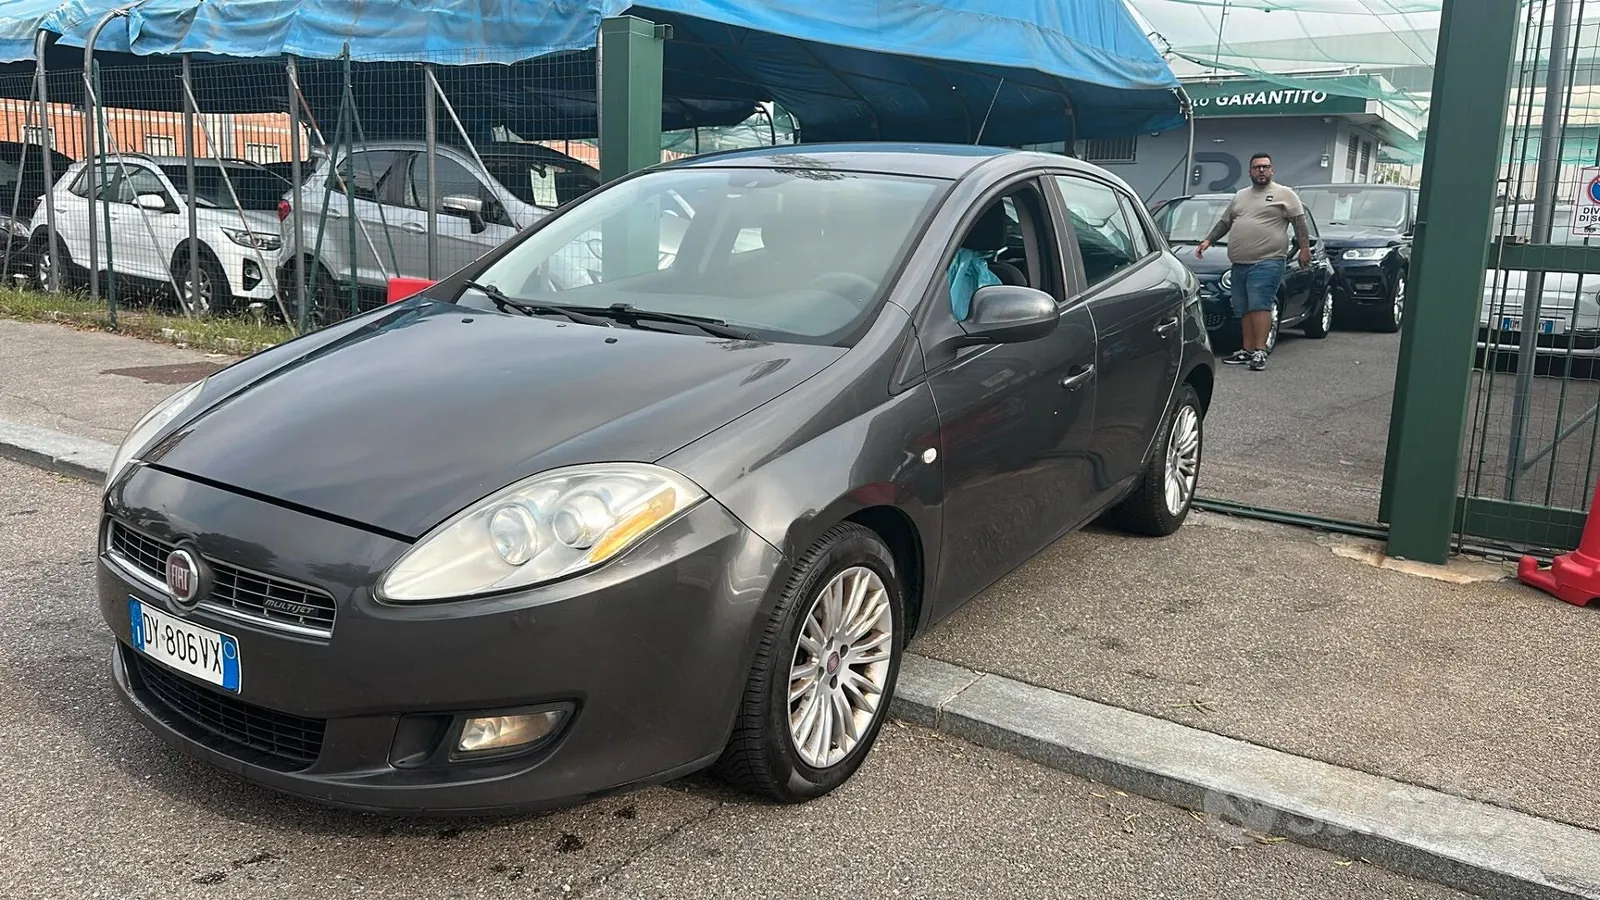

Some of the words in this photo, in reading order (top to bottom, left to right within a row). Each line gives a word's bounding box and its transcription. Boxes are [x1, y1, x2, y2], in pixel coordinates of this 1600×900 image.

[1215, 89, 1328, 106] GARANTITO
[171, 563, 190, 591] FIAT
[264, 599, 315, 614] MULTIJET
